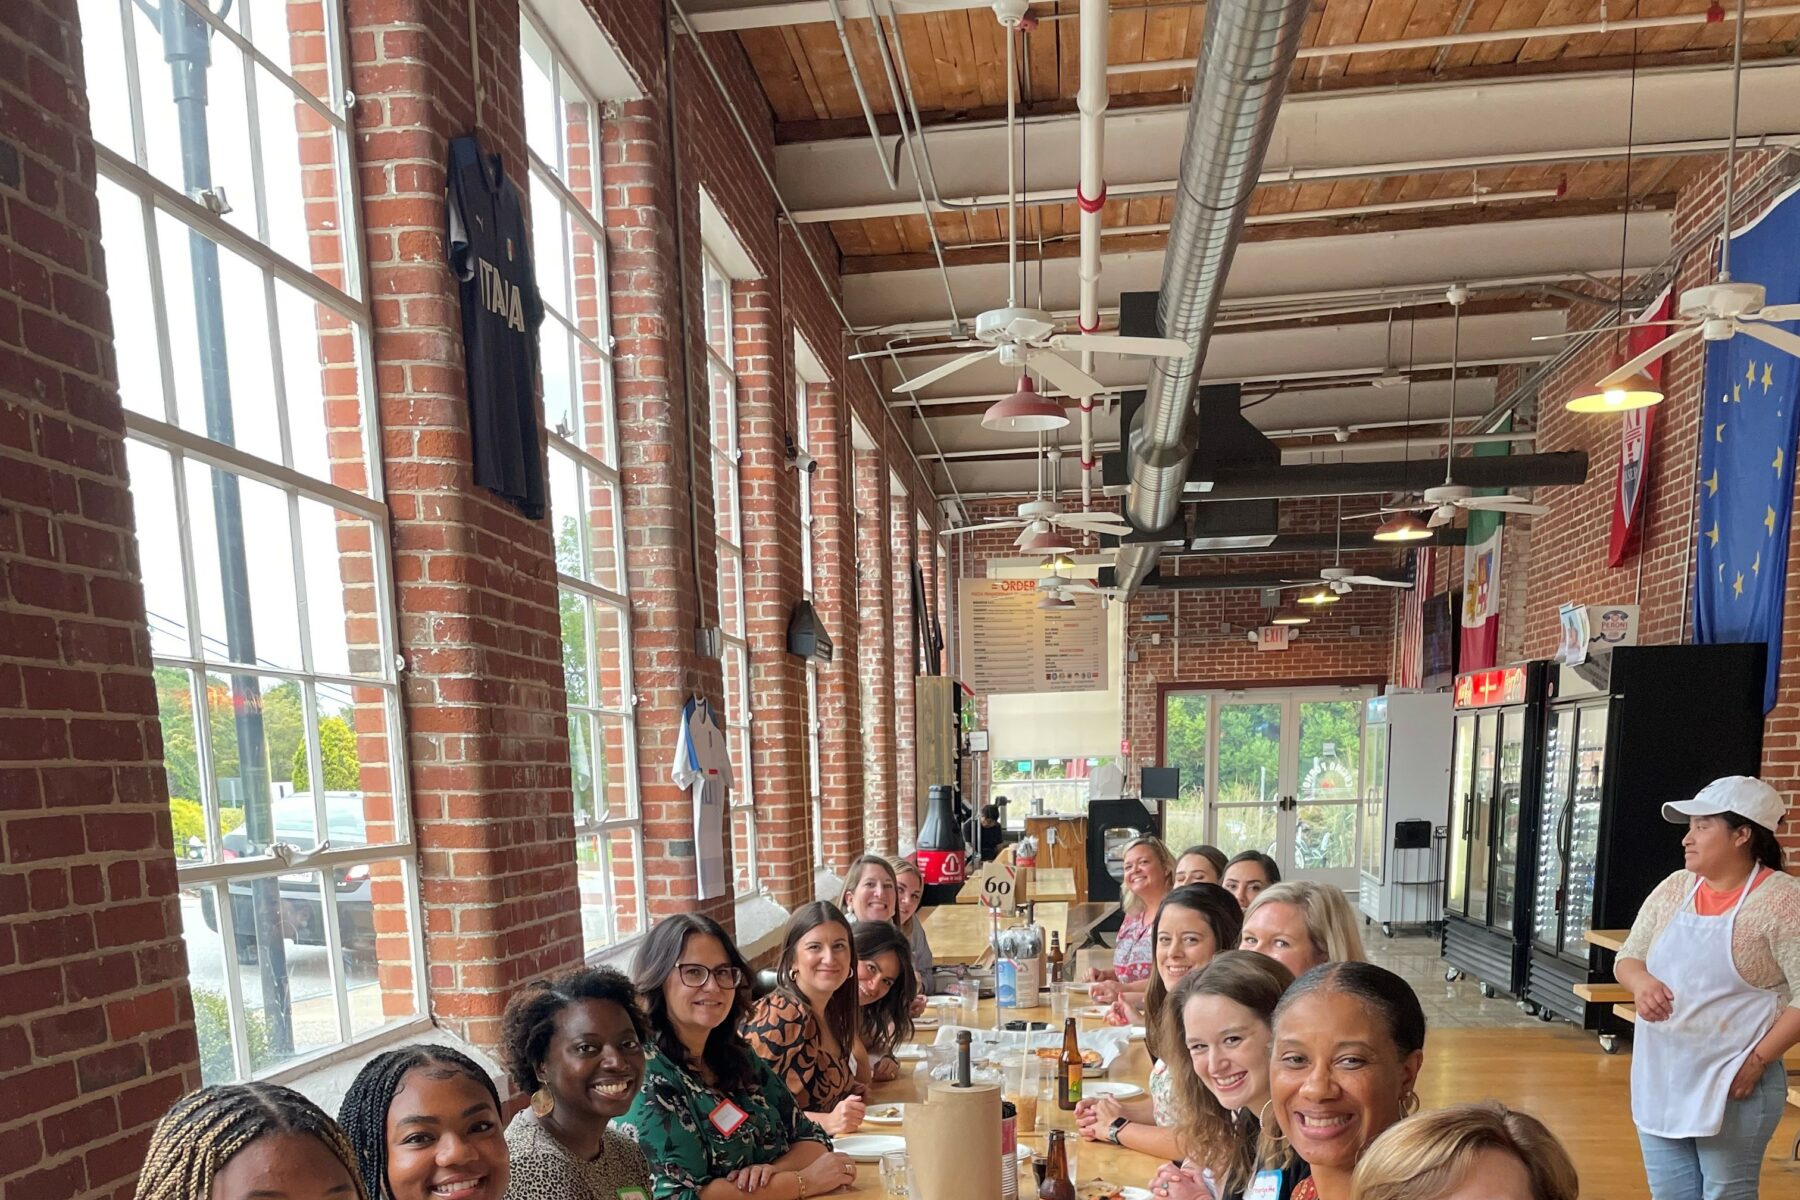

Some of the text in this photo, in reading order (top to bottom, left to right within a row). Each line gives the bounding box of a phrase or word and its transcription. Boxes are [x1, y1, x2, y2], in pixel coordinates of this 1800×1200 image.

[1001, 580, 1036, 592] ORDER
[1264, 627, 1284, 643] EXIT
[984, 875, 1011, 895] 60
